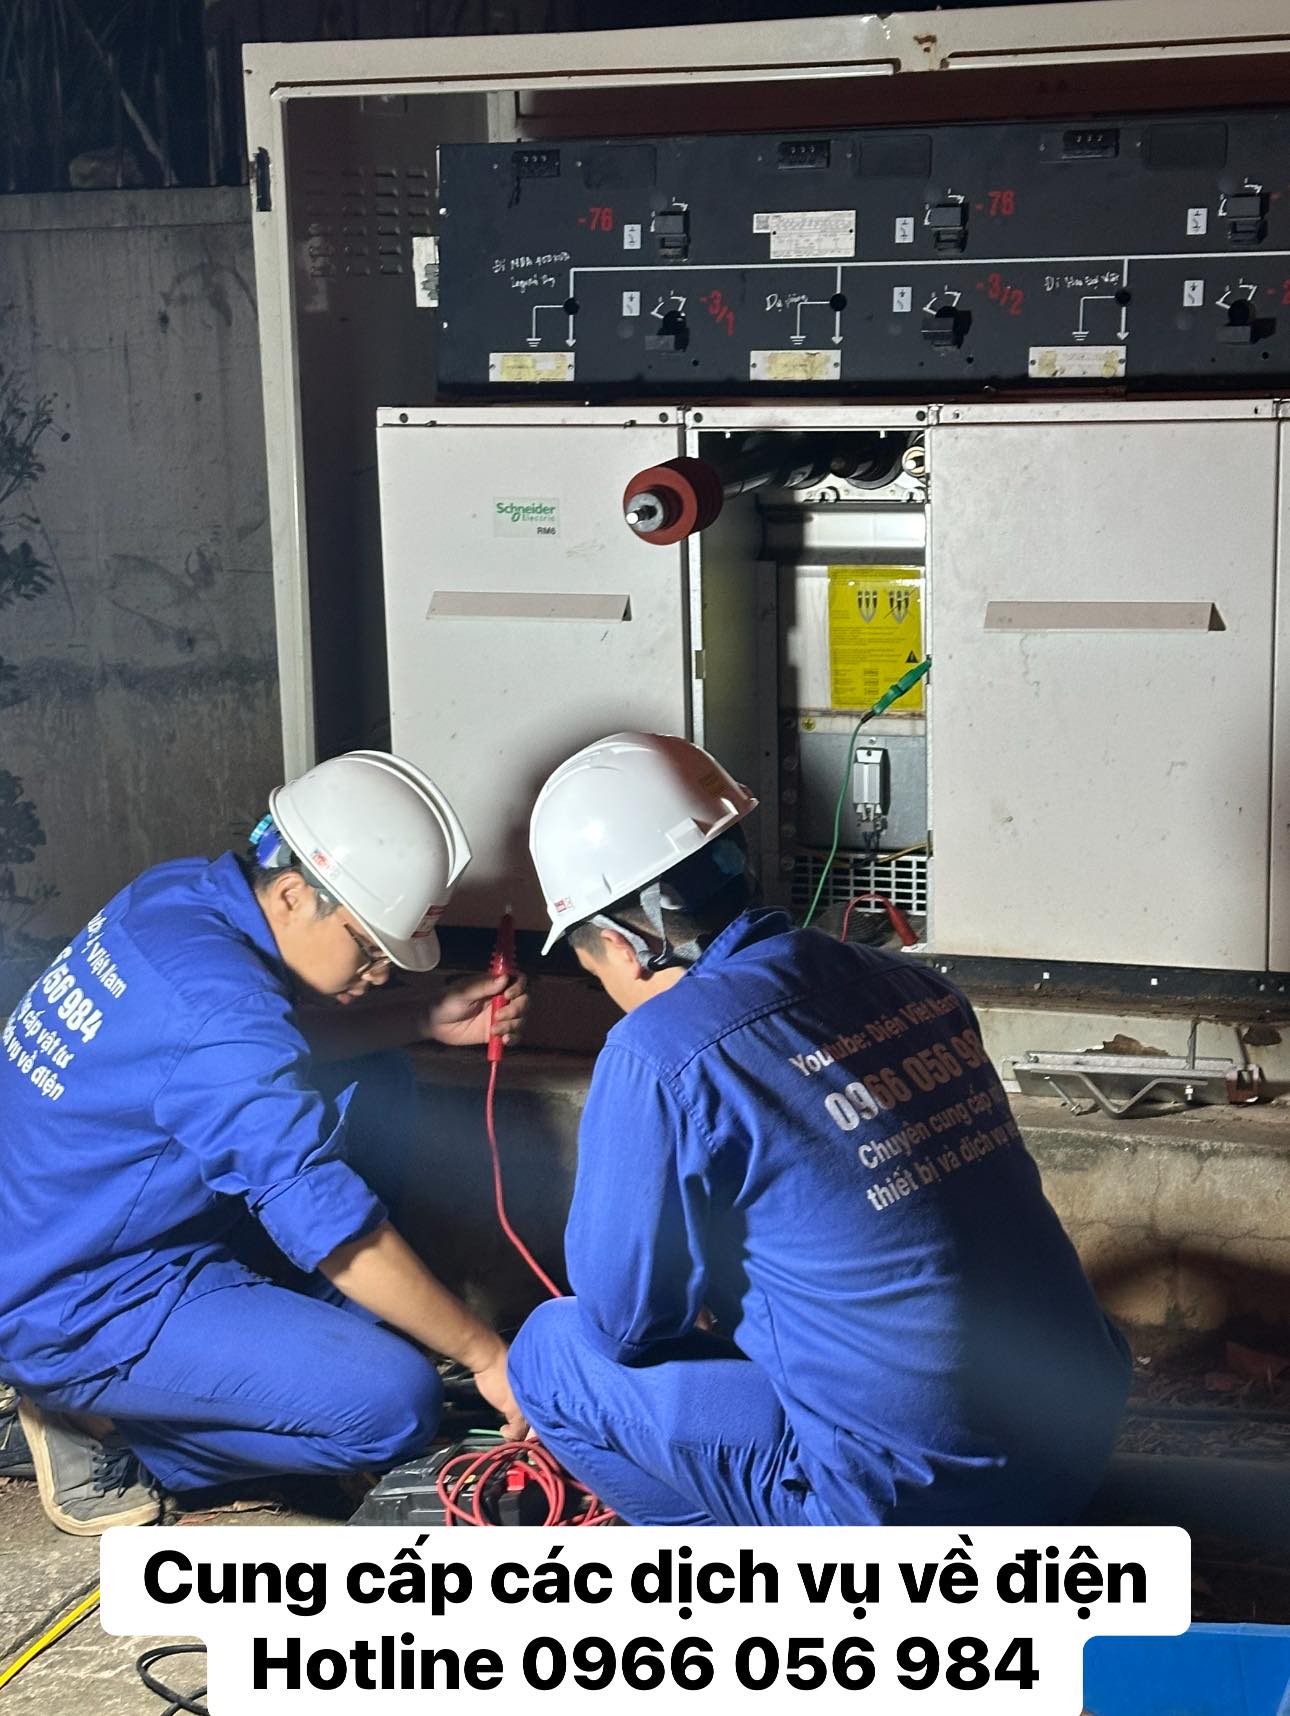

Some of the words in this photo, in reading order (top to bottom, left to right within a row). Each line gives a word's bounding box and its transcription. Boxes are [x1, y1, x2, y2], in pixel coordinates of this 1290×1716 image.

[496, 502, 556, 522] Schneider
[22, 1010, 46, 1038] cấp
[36, 1028, 62, 1056] vật
[52, 1043, 76, 1069] tư
[58, 987, 103, 1044] 984
[17, 1050, 38, 1074] về
[31, 1065, 65, 1101] điện
[824, 1066, 913, 1131] 0966
[902, 1042, 963, 1092] 056
[858, 1120, 931, 1169] Chuyên
[929, 1100, 974, 1134] cung
[867, 1166, 920, 1211] thiết
[914, 1155, 943, 1186] bị
[938, 1143, 962, 1174] và
